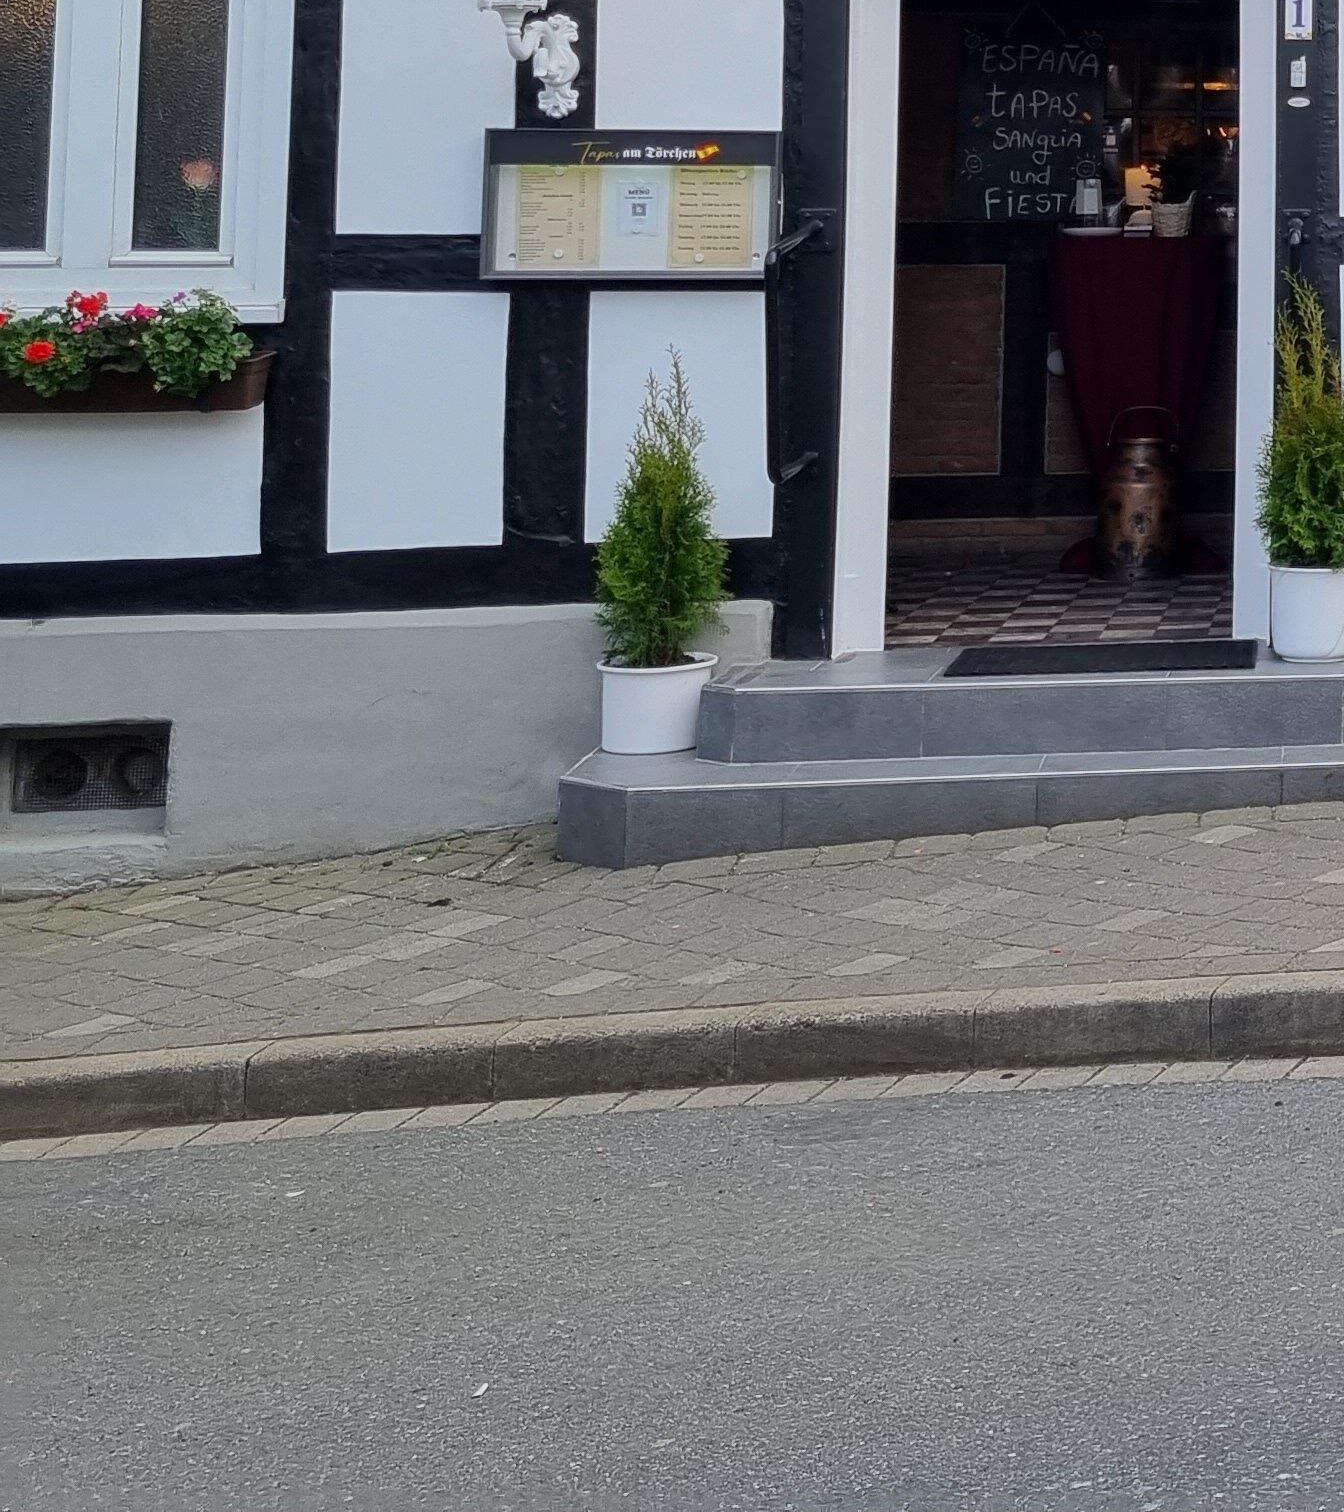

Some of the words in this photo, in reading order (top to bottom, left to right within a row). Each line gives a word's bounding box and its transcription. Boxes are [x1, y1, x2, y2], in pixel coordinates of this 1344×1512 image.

[982, 44, 1099, 78] ESPAÑA
[571, 141, 620, 165] Tapas
[622, 149, 641, 158] am
[645, 146, 697, 161] Törchen
[1010, 165, 1051, 185] und
